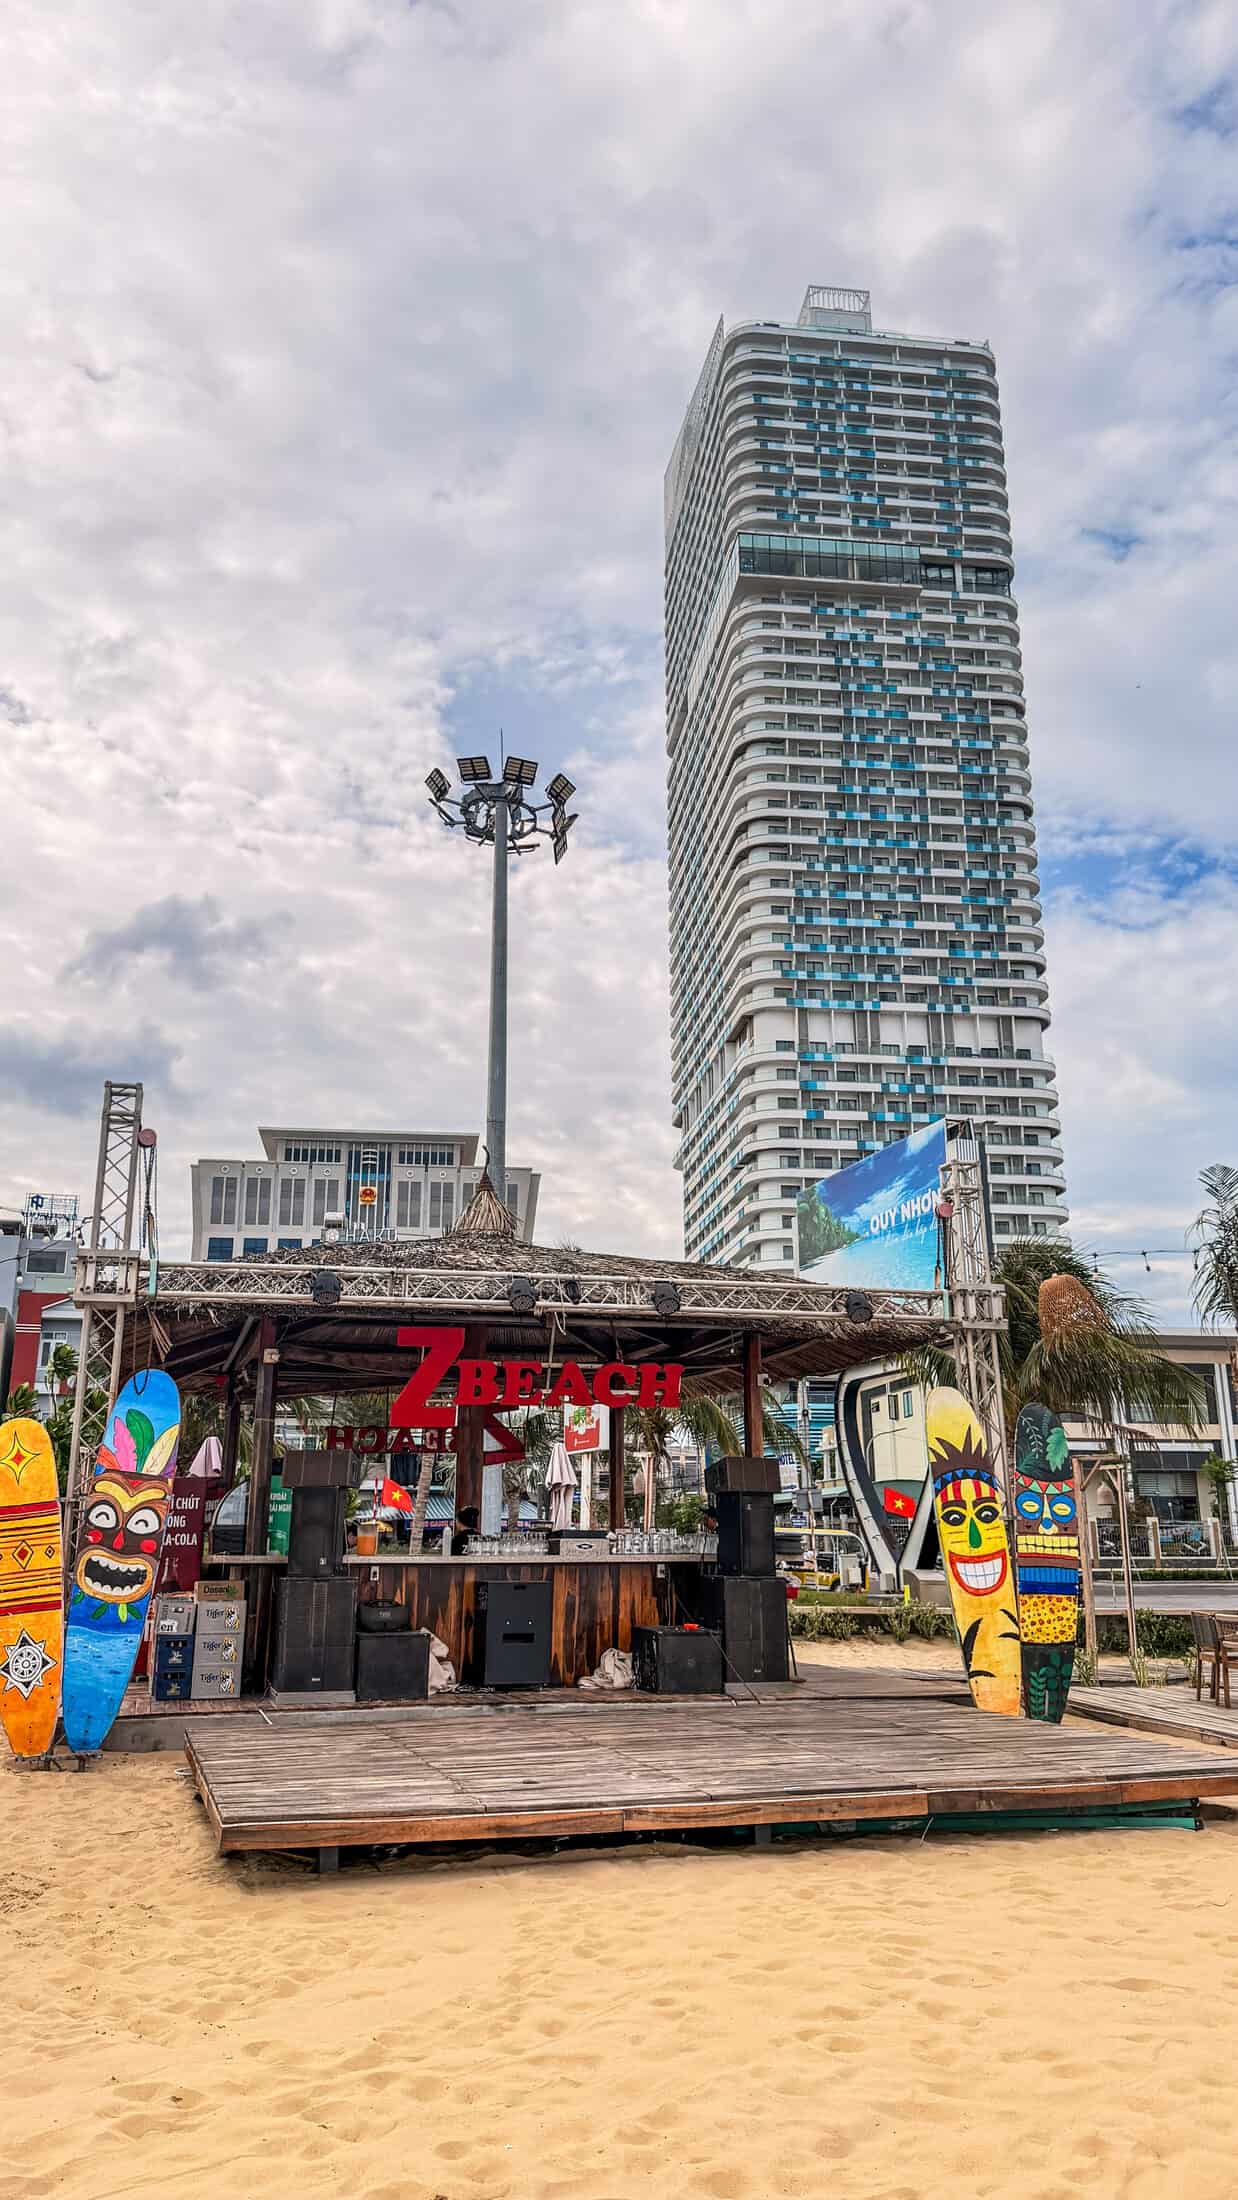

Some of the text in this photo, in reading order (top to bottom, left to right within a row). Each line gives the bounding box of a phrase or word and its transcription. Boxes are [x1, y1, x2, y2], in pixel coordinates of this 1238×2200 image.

[175, 1493, 200, 1510] CHÚT
[206, 1607, 225, 1619] Tiger
[203, 1641, 221, 1652] Tiger
[200, 1673, 218, 1683] Tiger
